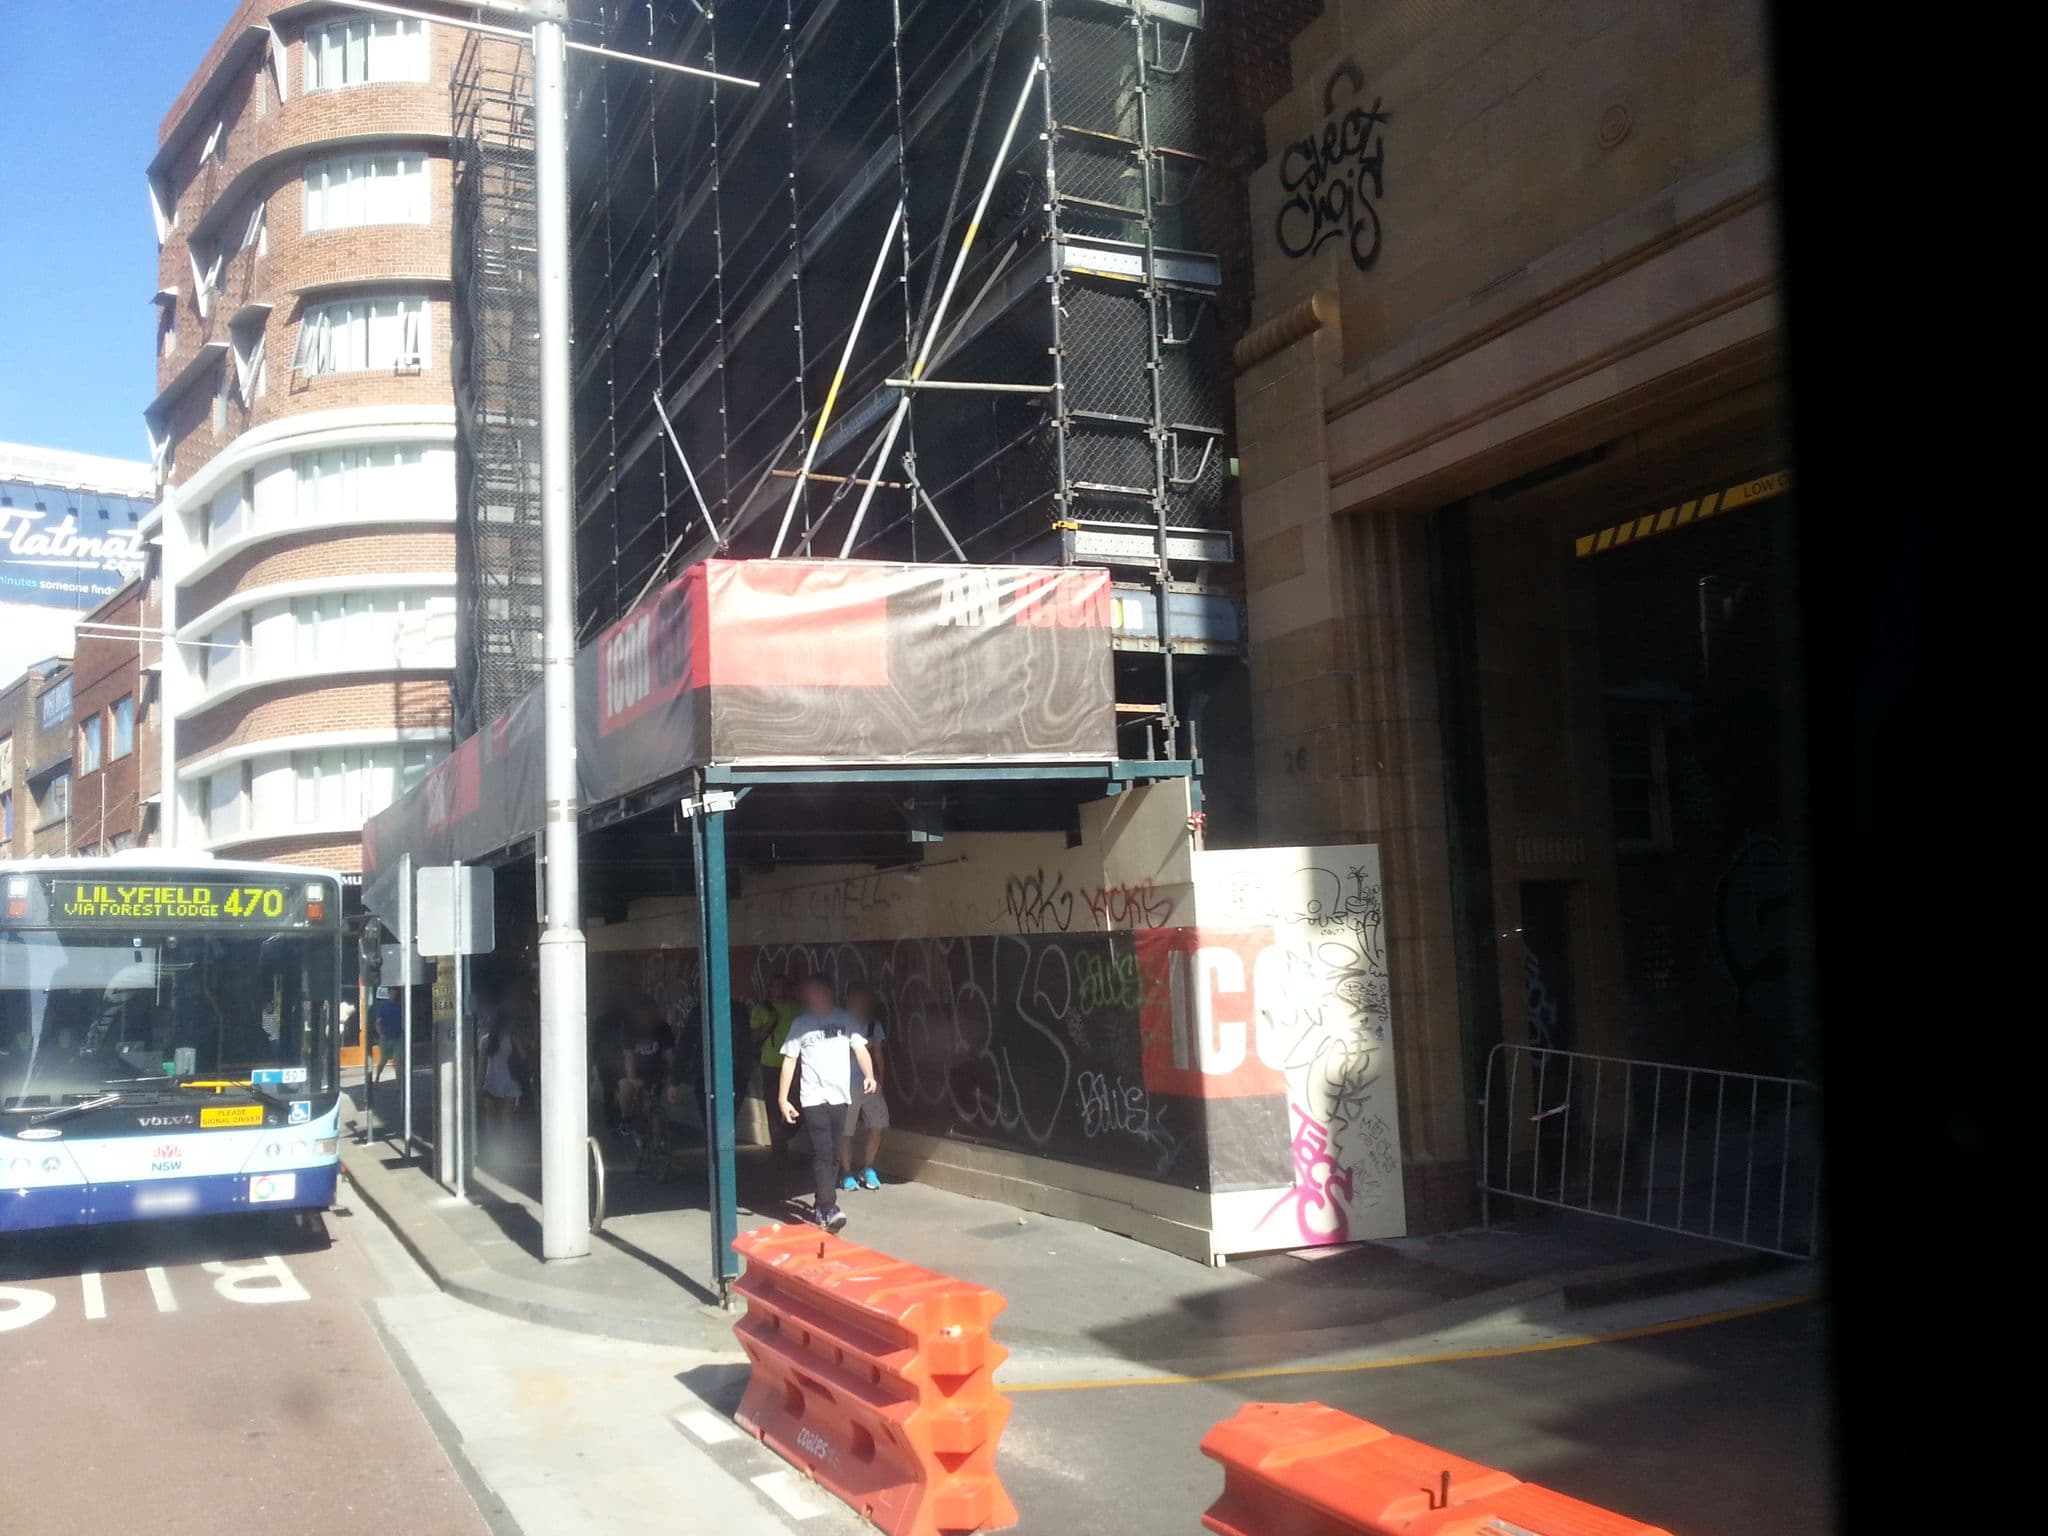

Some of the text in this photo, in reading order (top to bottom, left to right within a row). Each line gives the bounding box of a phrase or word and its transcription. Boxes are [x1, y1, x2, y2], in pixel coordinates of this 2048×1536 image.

[1743, 478, 1774, 498] LOW
[39, 579, 89, 593] someone
[606, 614, 651, 718] ICON
[76, 886, 211, 904] LILYFIELD
[223, 888, 283, 917] 470
[64, 903, 219, 917] VIA FOREST LODGE
[137, 1115, 193, 1127] VOLVO
[151, 1161, 182, 1172] NSW
